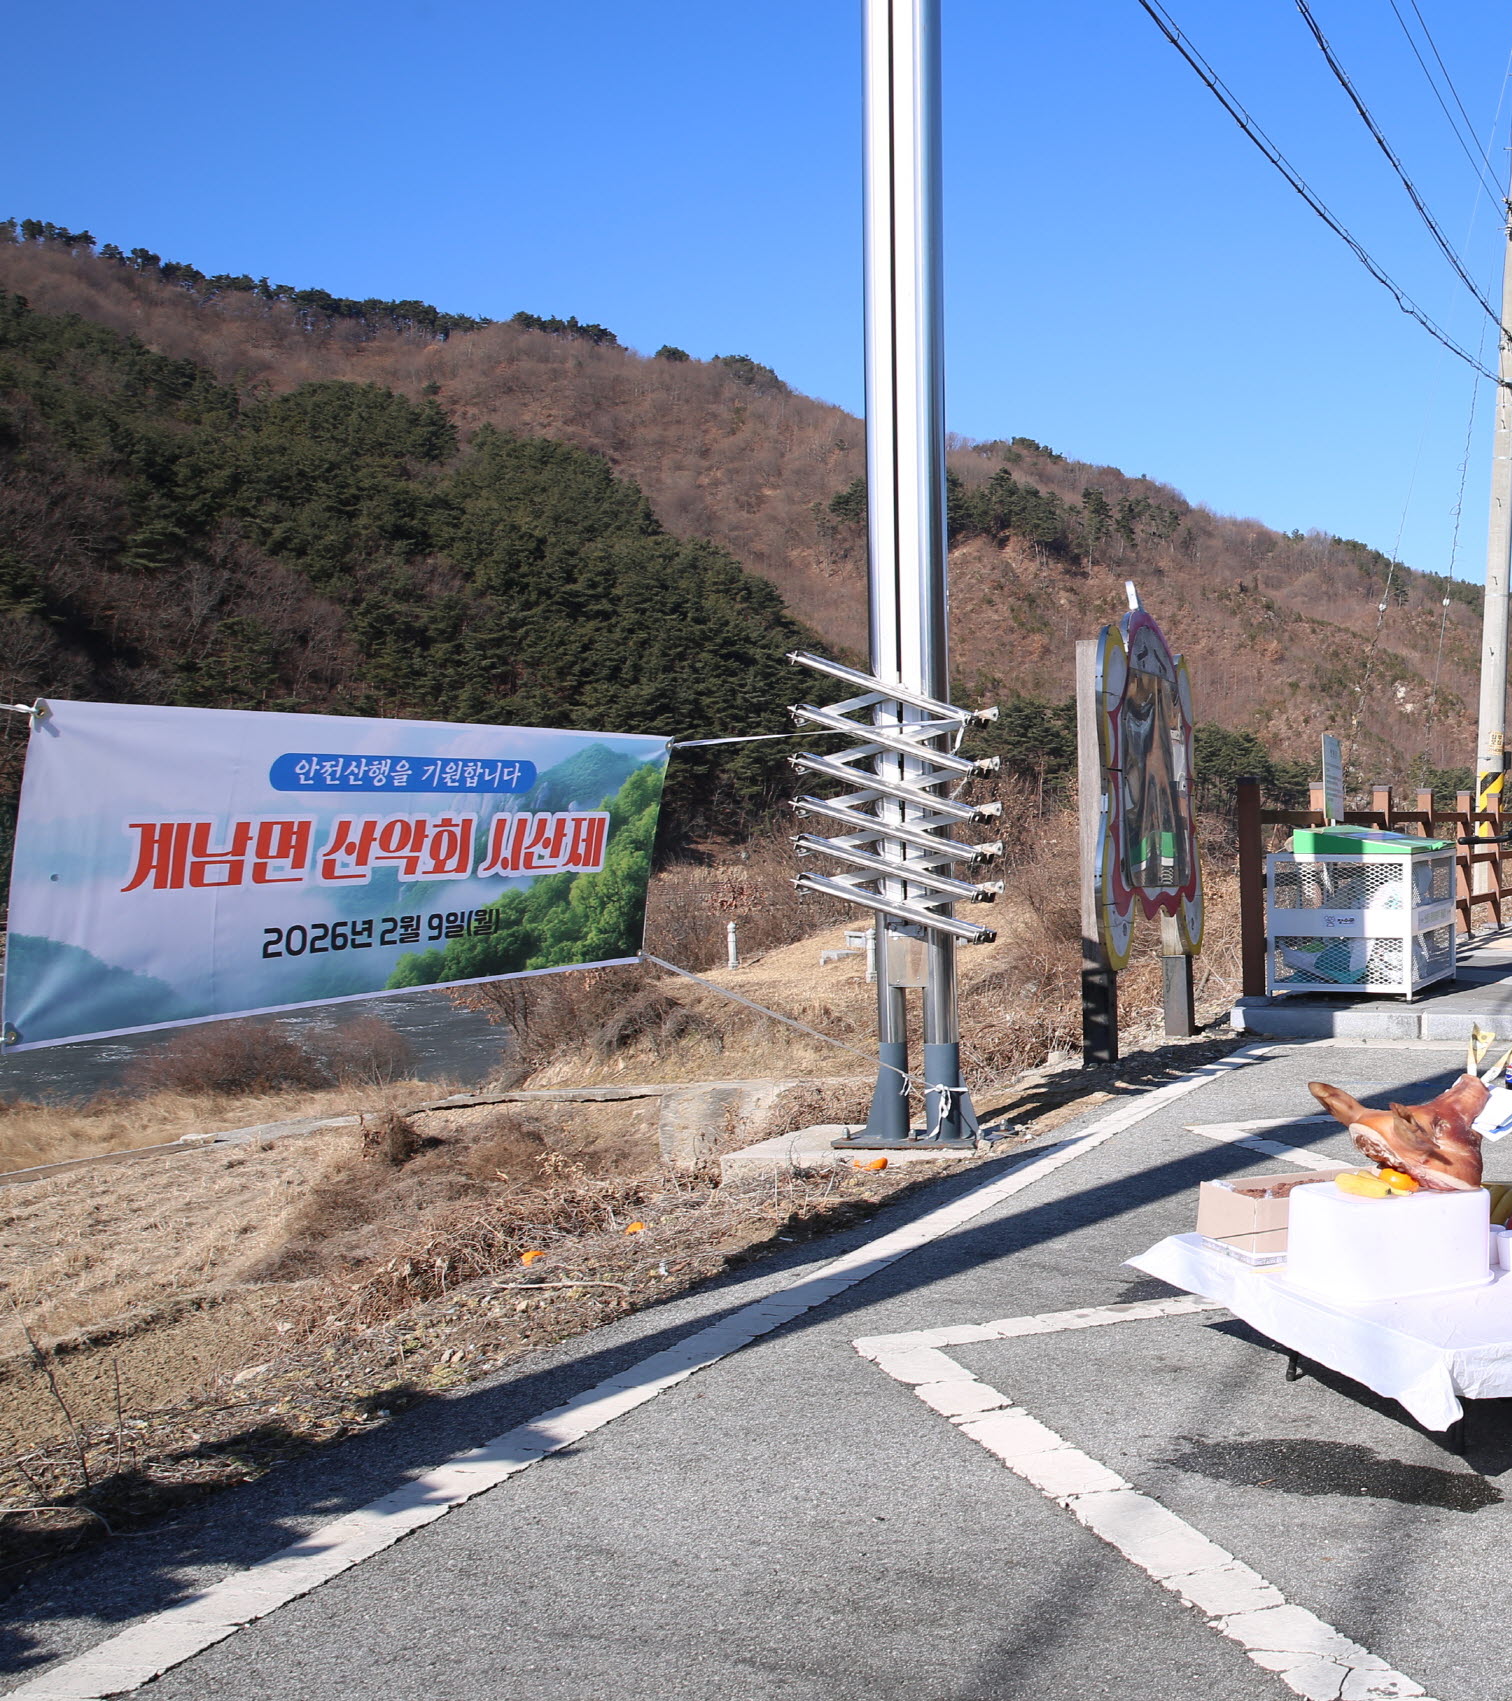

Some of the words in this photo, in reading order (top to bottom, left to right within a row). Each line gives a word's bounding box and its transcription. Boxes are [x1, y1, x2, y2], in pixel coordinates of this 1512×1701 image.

[294, 757, 412, 787] 안전산행을
[421, 760, 521, 788] 기원합니다
[120, 820, 312, 893] 계남면
[321, 817, 473, 881] 산악회
[482, 817, 606, 872] 시산제
[262, 919, 373, 959] 2026년
[380, 914, 421, 946] 2월
[427, 908, 498, 942] 9일(월)
